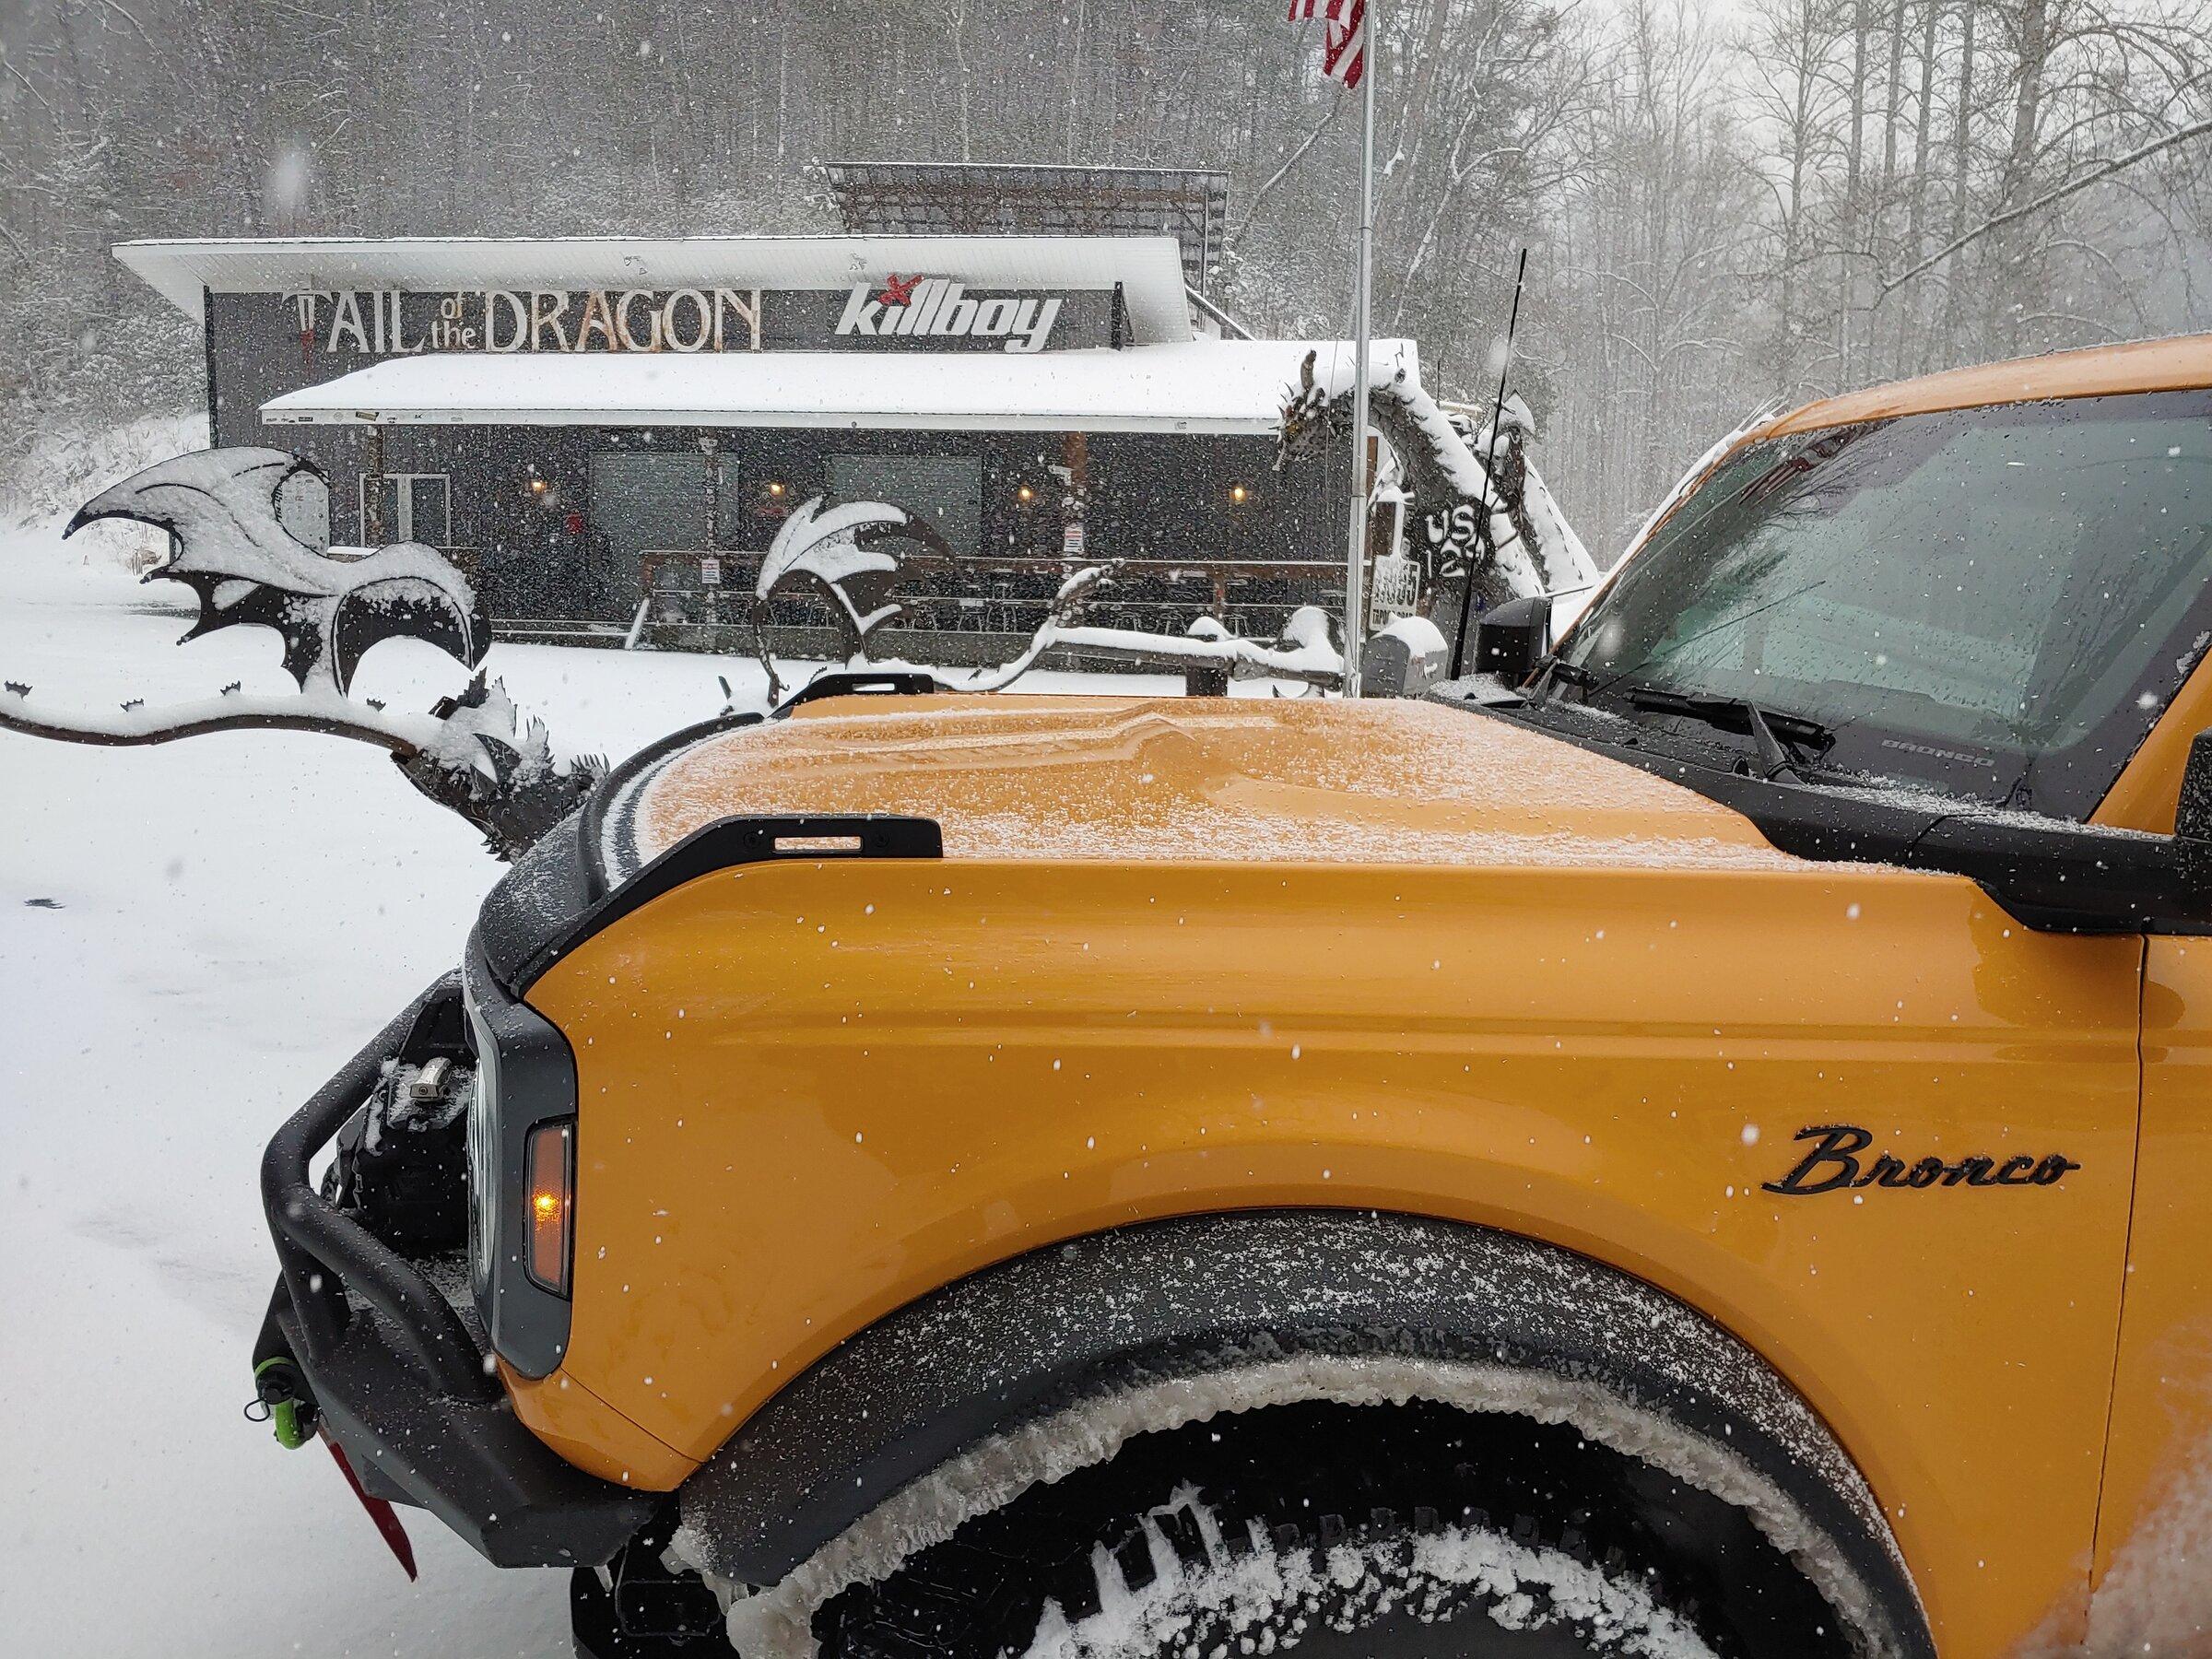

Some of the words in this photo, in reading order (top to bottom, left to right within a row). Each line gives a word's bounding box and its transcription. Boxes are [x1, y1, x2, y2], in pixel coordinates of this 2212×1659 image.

[281, 290, 427, 353] TAIL
[441, 290, 465, 320] of
[485, 288, 761, 353] DRAGON
[834, 276, 1062, 353] killboy
[431, 321, 477, 349] the
[1424, 504, 1475, 544] US
[1881, 739, 1995, 768] BRONCO
[1761, 1124, 2081, 1195] Bronco
